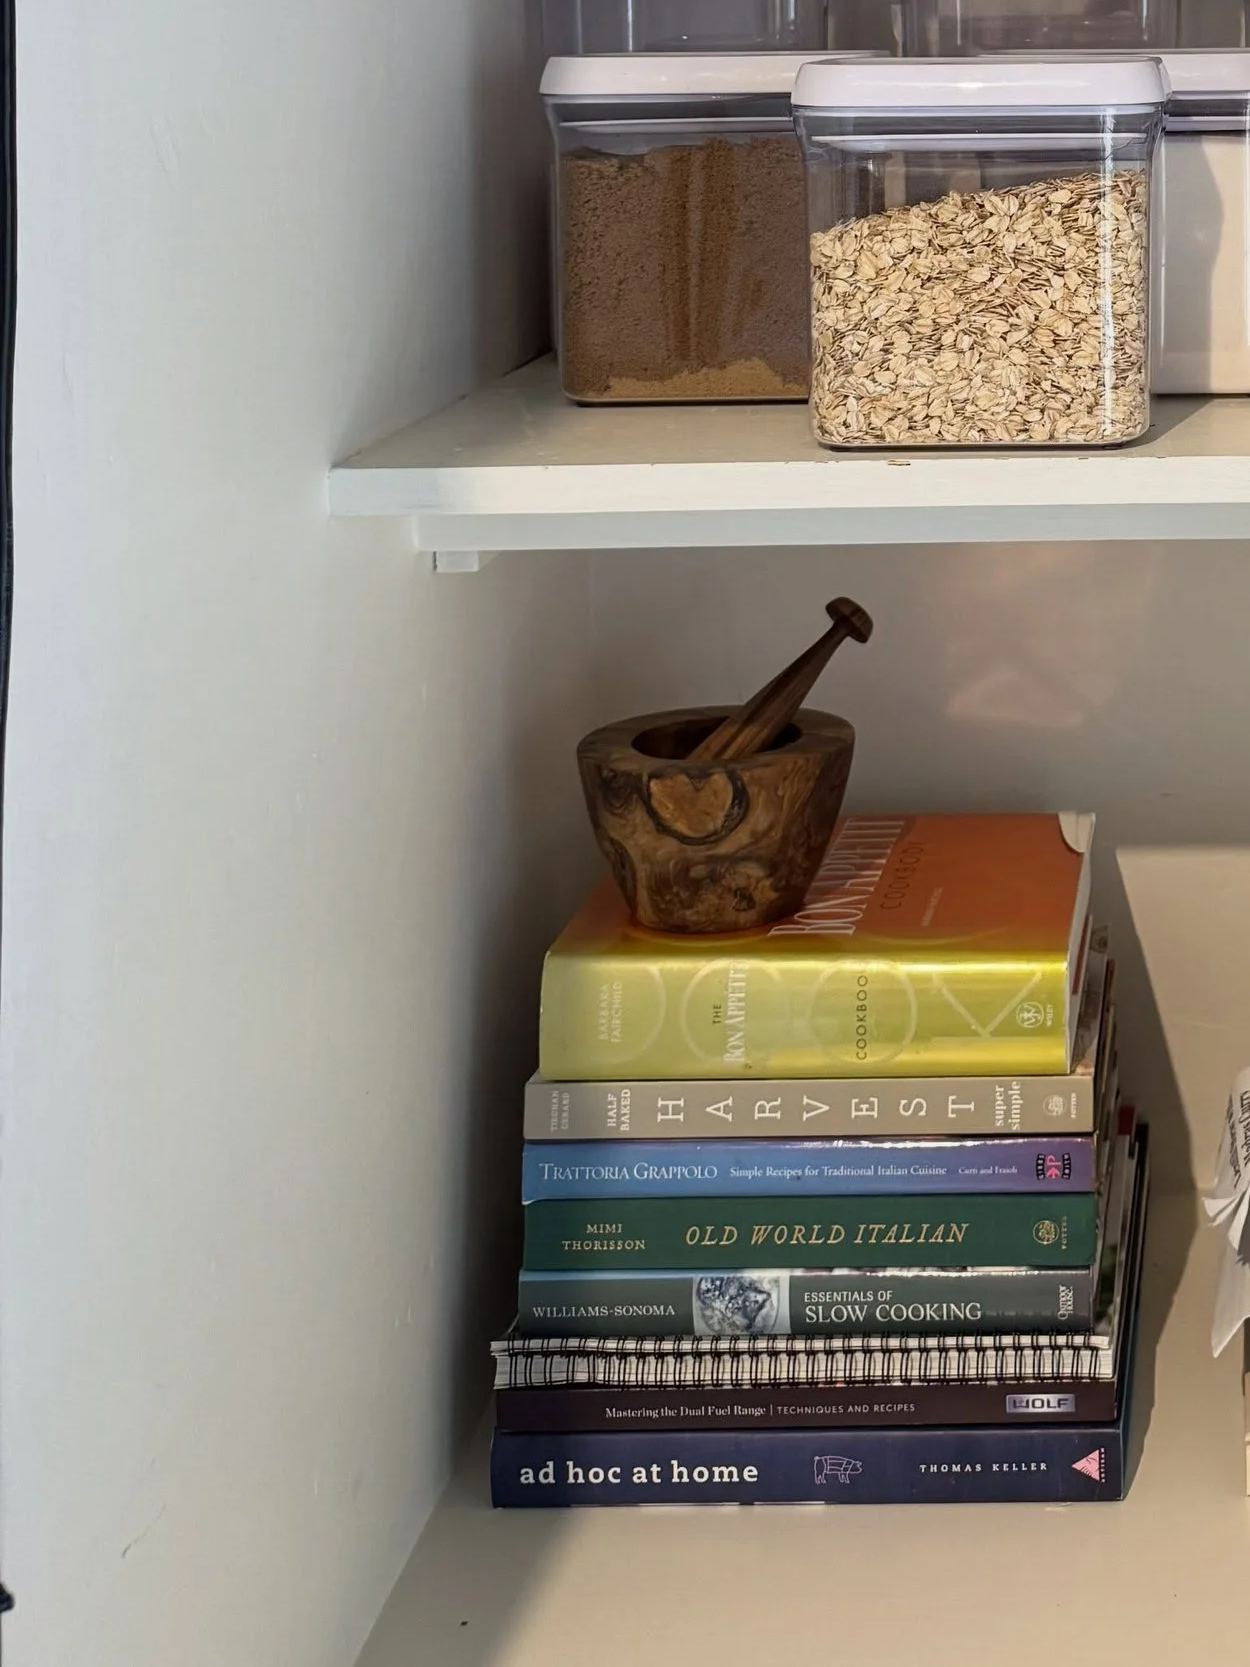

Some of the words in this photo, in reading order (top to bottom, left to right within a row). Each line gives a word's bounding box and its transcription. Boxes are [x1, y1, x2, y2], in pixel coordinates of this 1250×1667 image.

[712, 1003, 722, 1025] THE
[855, 974, 868, 1061] COOKBOO
[607, 1093, 617, 1127] HALF
[620, 1089, 631, 1131] BAKED
[994, 1085, 1007, 1127] super
[1008, 1081, 1024, 1131] simple
[539, 1163, 629, 1180] TRATTORIA
[633, 1162, 718, 1180] GRAPPOLO
[730, 1167, 762, 1180] Simple
[766, 1167, 802, 1179] Recipes
[805, 1166, 819, 1176] for
[822, 1165, 874, 1177] Traditional
[877, 1164, 908, 1176] Italian
[910, 1164, 947, 1176] Cuisine
[585, 1223, 623, 1234] MIMI
[686, 1225, 738, 1246] OLD
[750, 1223, 845, 1246] WORLD
[853, 1222, 969, 1244] ITALIAN
[562, 1239, 646, 1251] THORISSON
[804, 1291, 873, 1303] ESSENTIALS
[876, 1289, 892, 1302] OF
[533, 1304, 676, 1318] WILLIAMS-SONOMA
[805, 1304, 868, 1323] SLOW
[875, 1302, 982, 1322] COOKING
[605, 1406, 660, 1419] Mastering
[660, 1406, 678, 1417] the
[680, 1405, 704, 1416] Dual
[706, 1405, 731, 1416] Fuel
[733, 1405, 767, 1418] Range
[777, 1405, 845, 1415] TECHNIQUES
[848, 1404, 870, 1413] AND
[873, 1403, 916, 1413] RECIPES
[1013, 1398, 1069, 1409] WOLF
[519, 1460, 556, 1484] ad
[566, 1459, 621, 1484] hoc
[632, 1463, 661, 1483] at
[671, 1460, 759, 1483] home
[919, 1463, 983, 1474] THOMAS
[992, 1462, 1048, 1472] KELLER
